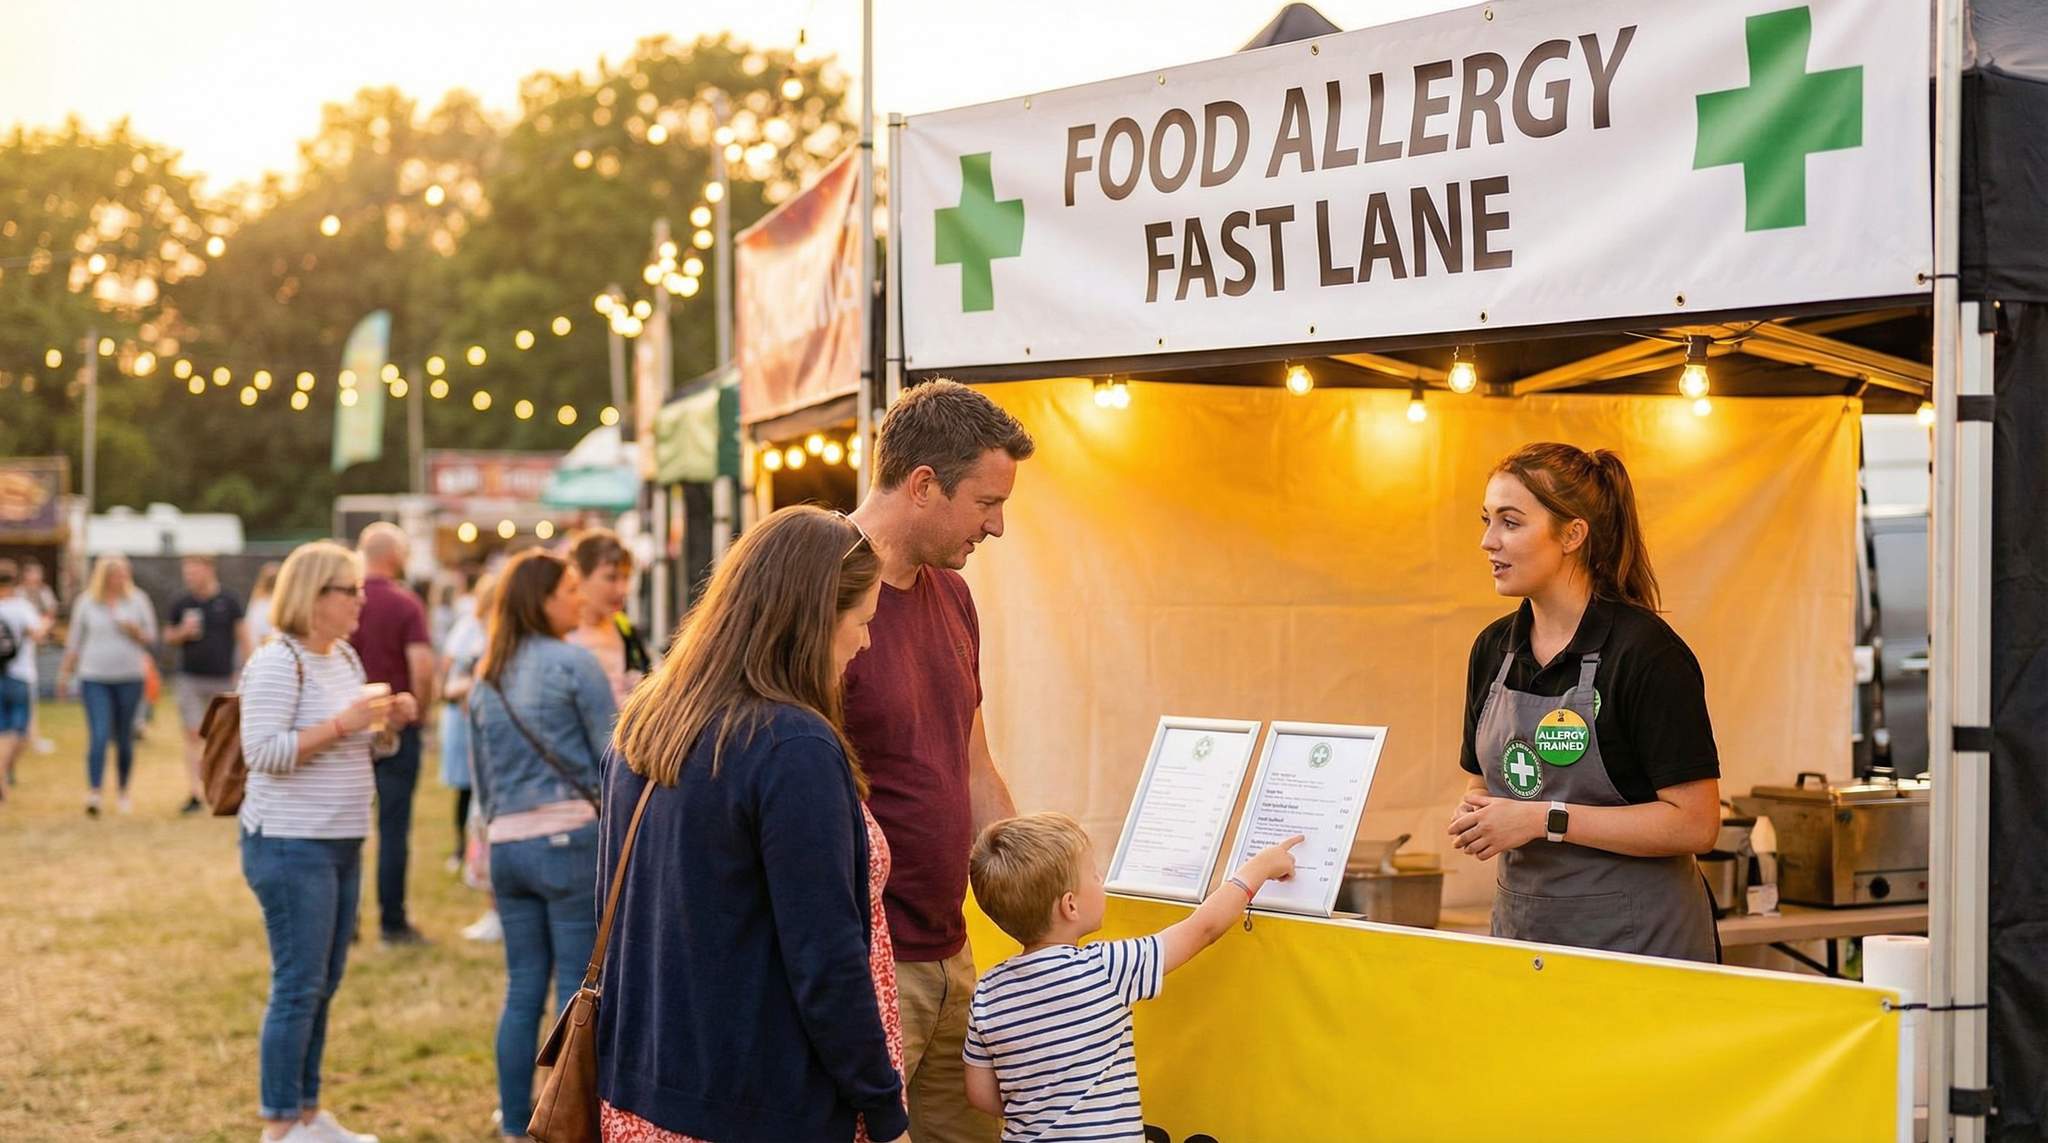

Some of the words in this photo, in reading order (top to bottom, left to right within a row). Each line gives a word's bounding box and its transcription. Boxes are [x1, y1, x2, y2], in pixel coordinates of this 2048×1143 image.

[1064, 100, 1250, 208] FOOD
[1265, 24, 1638, 179] ALLERGY
[1144, 204, 1296, 303] FAST
[1315, 174, 1513, 288] LANE
[1537, 741, 1584, 750] TRAINED
[1538, 731, 1586, 740] ALLERGY
